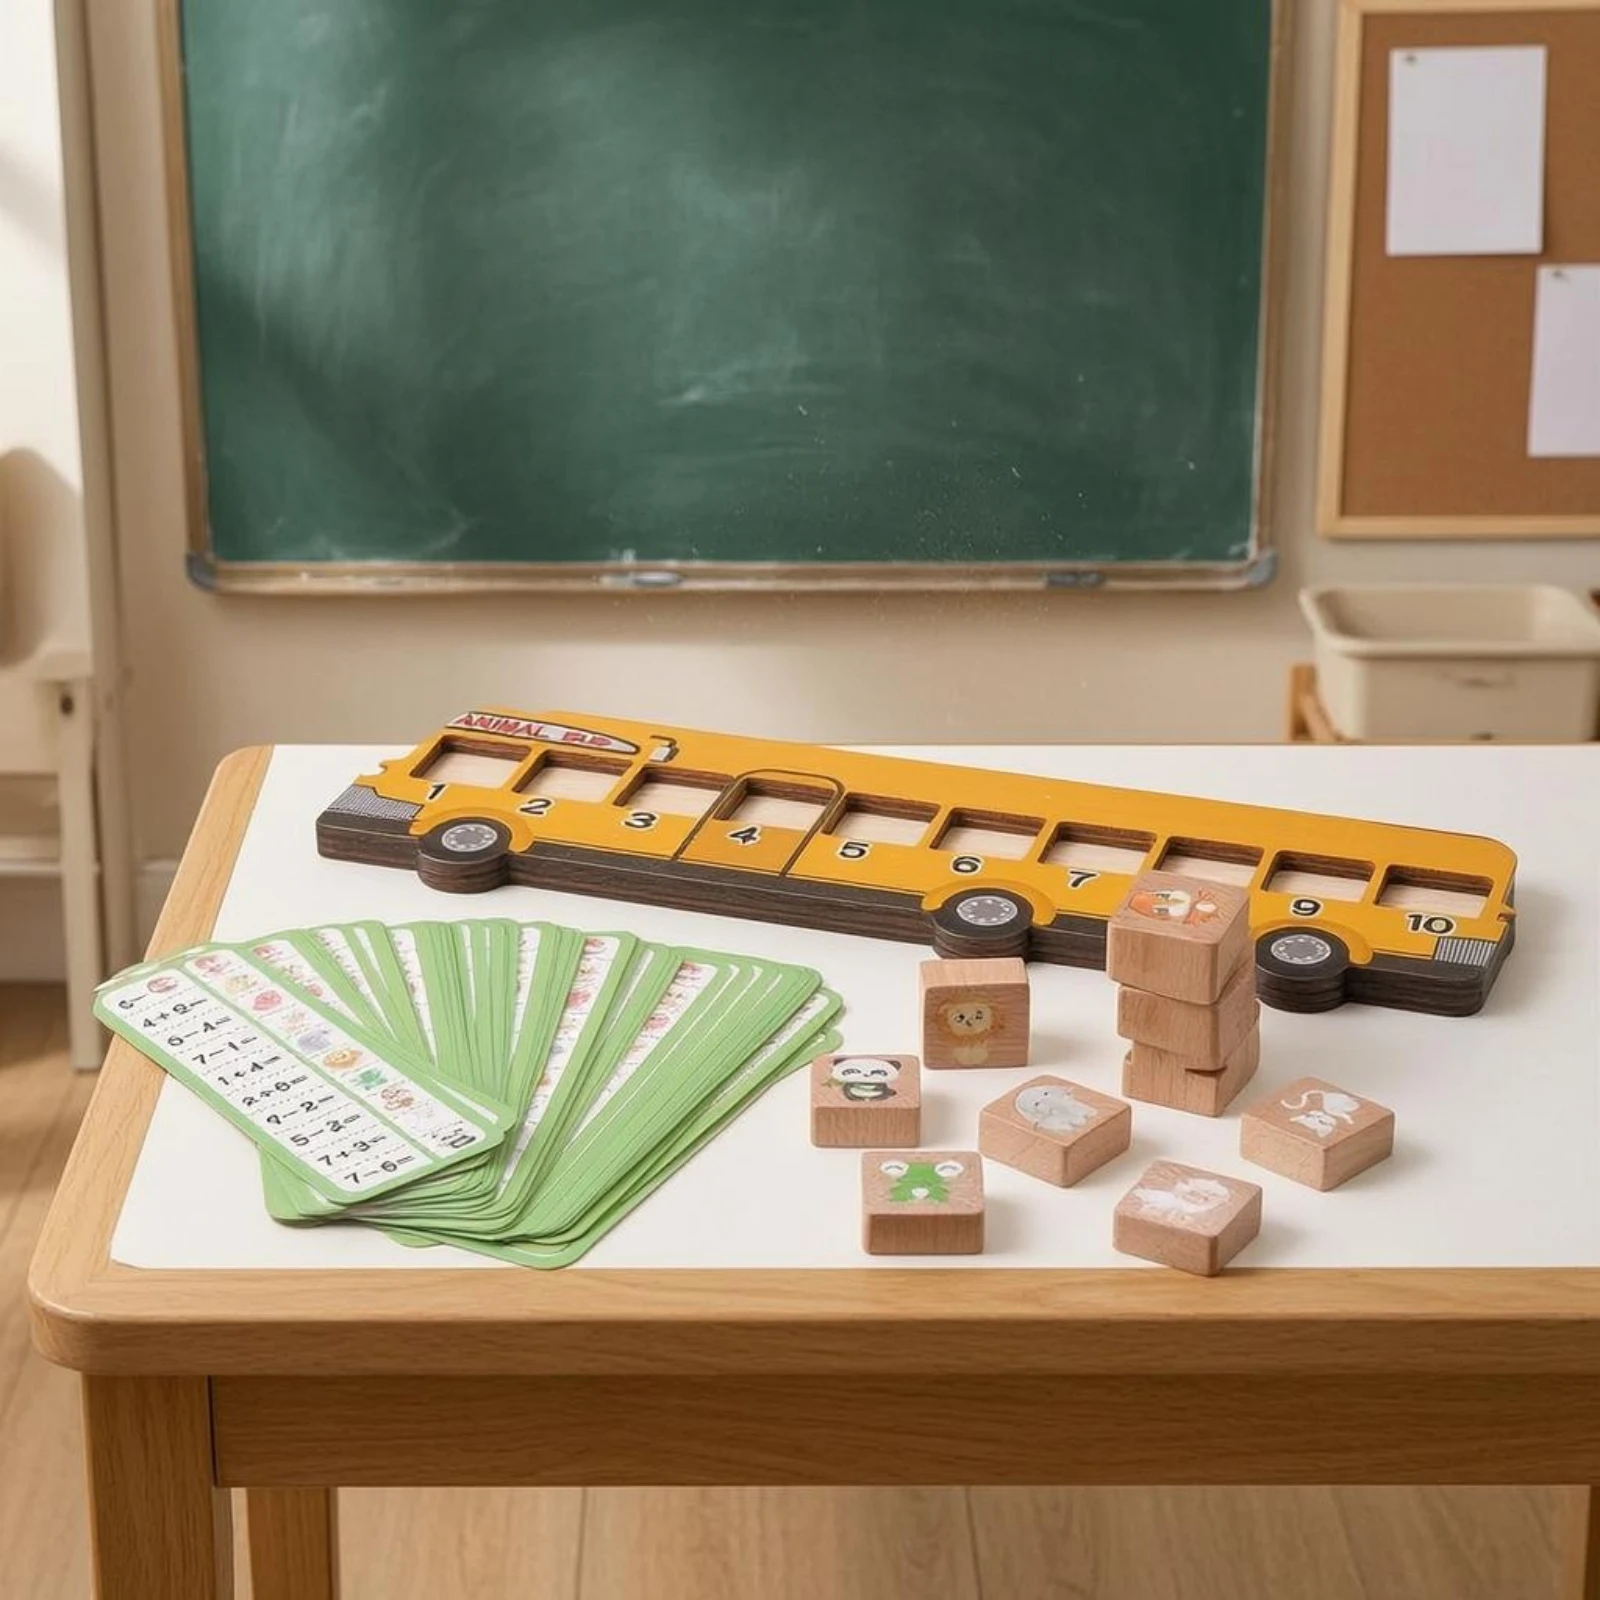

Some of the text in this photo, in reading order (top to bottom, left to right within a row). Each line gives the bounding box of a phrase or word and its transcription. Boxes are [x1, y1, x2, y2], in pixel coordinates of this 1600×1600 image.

[454, 714, 550, 739] ANIMAL
[427, 783, 447, 801] 1
[518, 797, 552, 816] 2
[623, 811, 658, 829] 3
[728, 825, 758, 844] 4
[838, 841, 870, 860] 5
[951, 855, 981, 873] 6
[1068, 870, 1097, 888] 7
[1290, 899, 1321, 917] 9
[1407, 913, 1455, 935] 10
